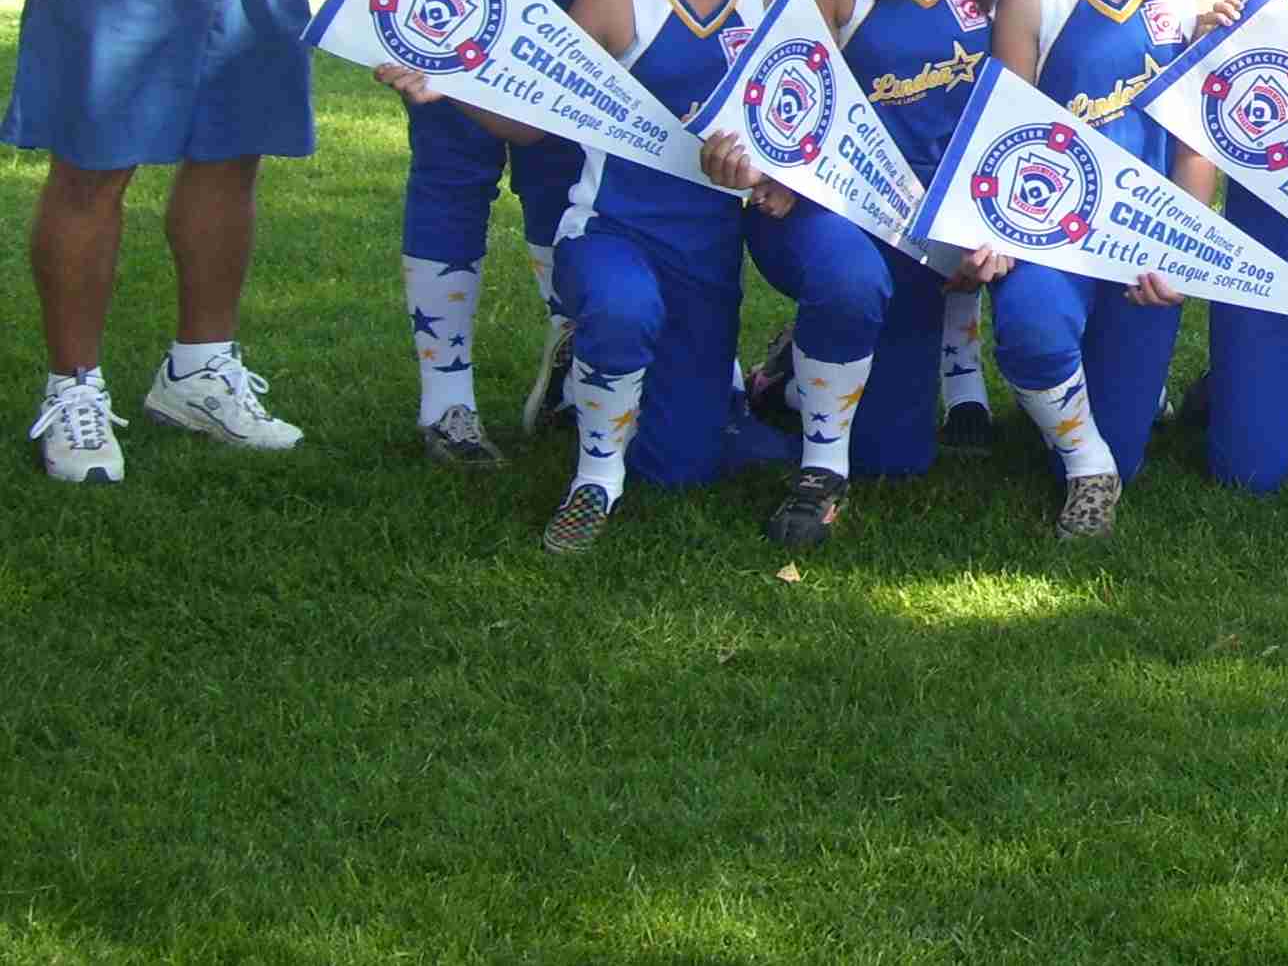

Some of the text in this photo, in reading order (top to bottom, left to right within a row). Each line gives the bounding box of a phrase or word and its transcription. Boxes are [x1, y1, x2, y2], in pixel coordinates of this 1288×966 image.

[384, 29, 442, 68] LOYALTY
[519, 2, 603, 79] California
[473, 58, 664, 157] Little League SOFTBALL
[508, 34, 669, 143] CHAMPIONS 2009
[869, 62, 954, 103] Linden
[751, 122, 790, 161] LOYALTY
[845, 101, 899, 178] California
[983, 128, 1044, 172] CHARACTER
[1208, 114, 1251, 161] LOYALTY
[811, 154, 858, 203] Little
[837, 133, 912, 220] CHAMPIONS
[1071, 145, 1096, 212] COURAGE
[1114, 166, 1202, 232] California
[989, 213, 1048, 244] LOYALTY
[1108, 200, 1275, 284] CHAMPIONS 2009
[1078, 227, 1272, 298] Little League SOFTBALL
